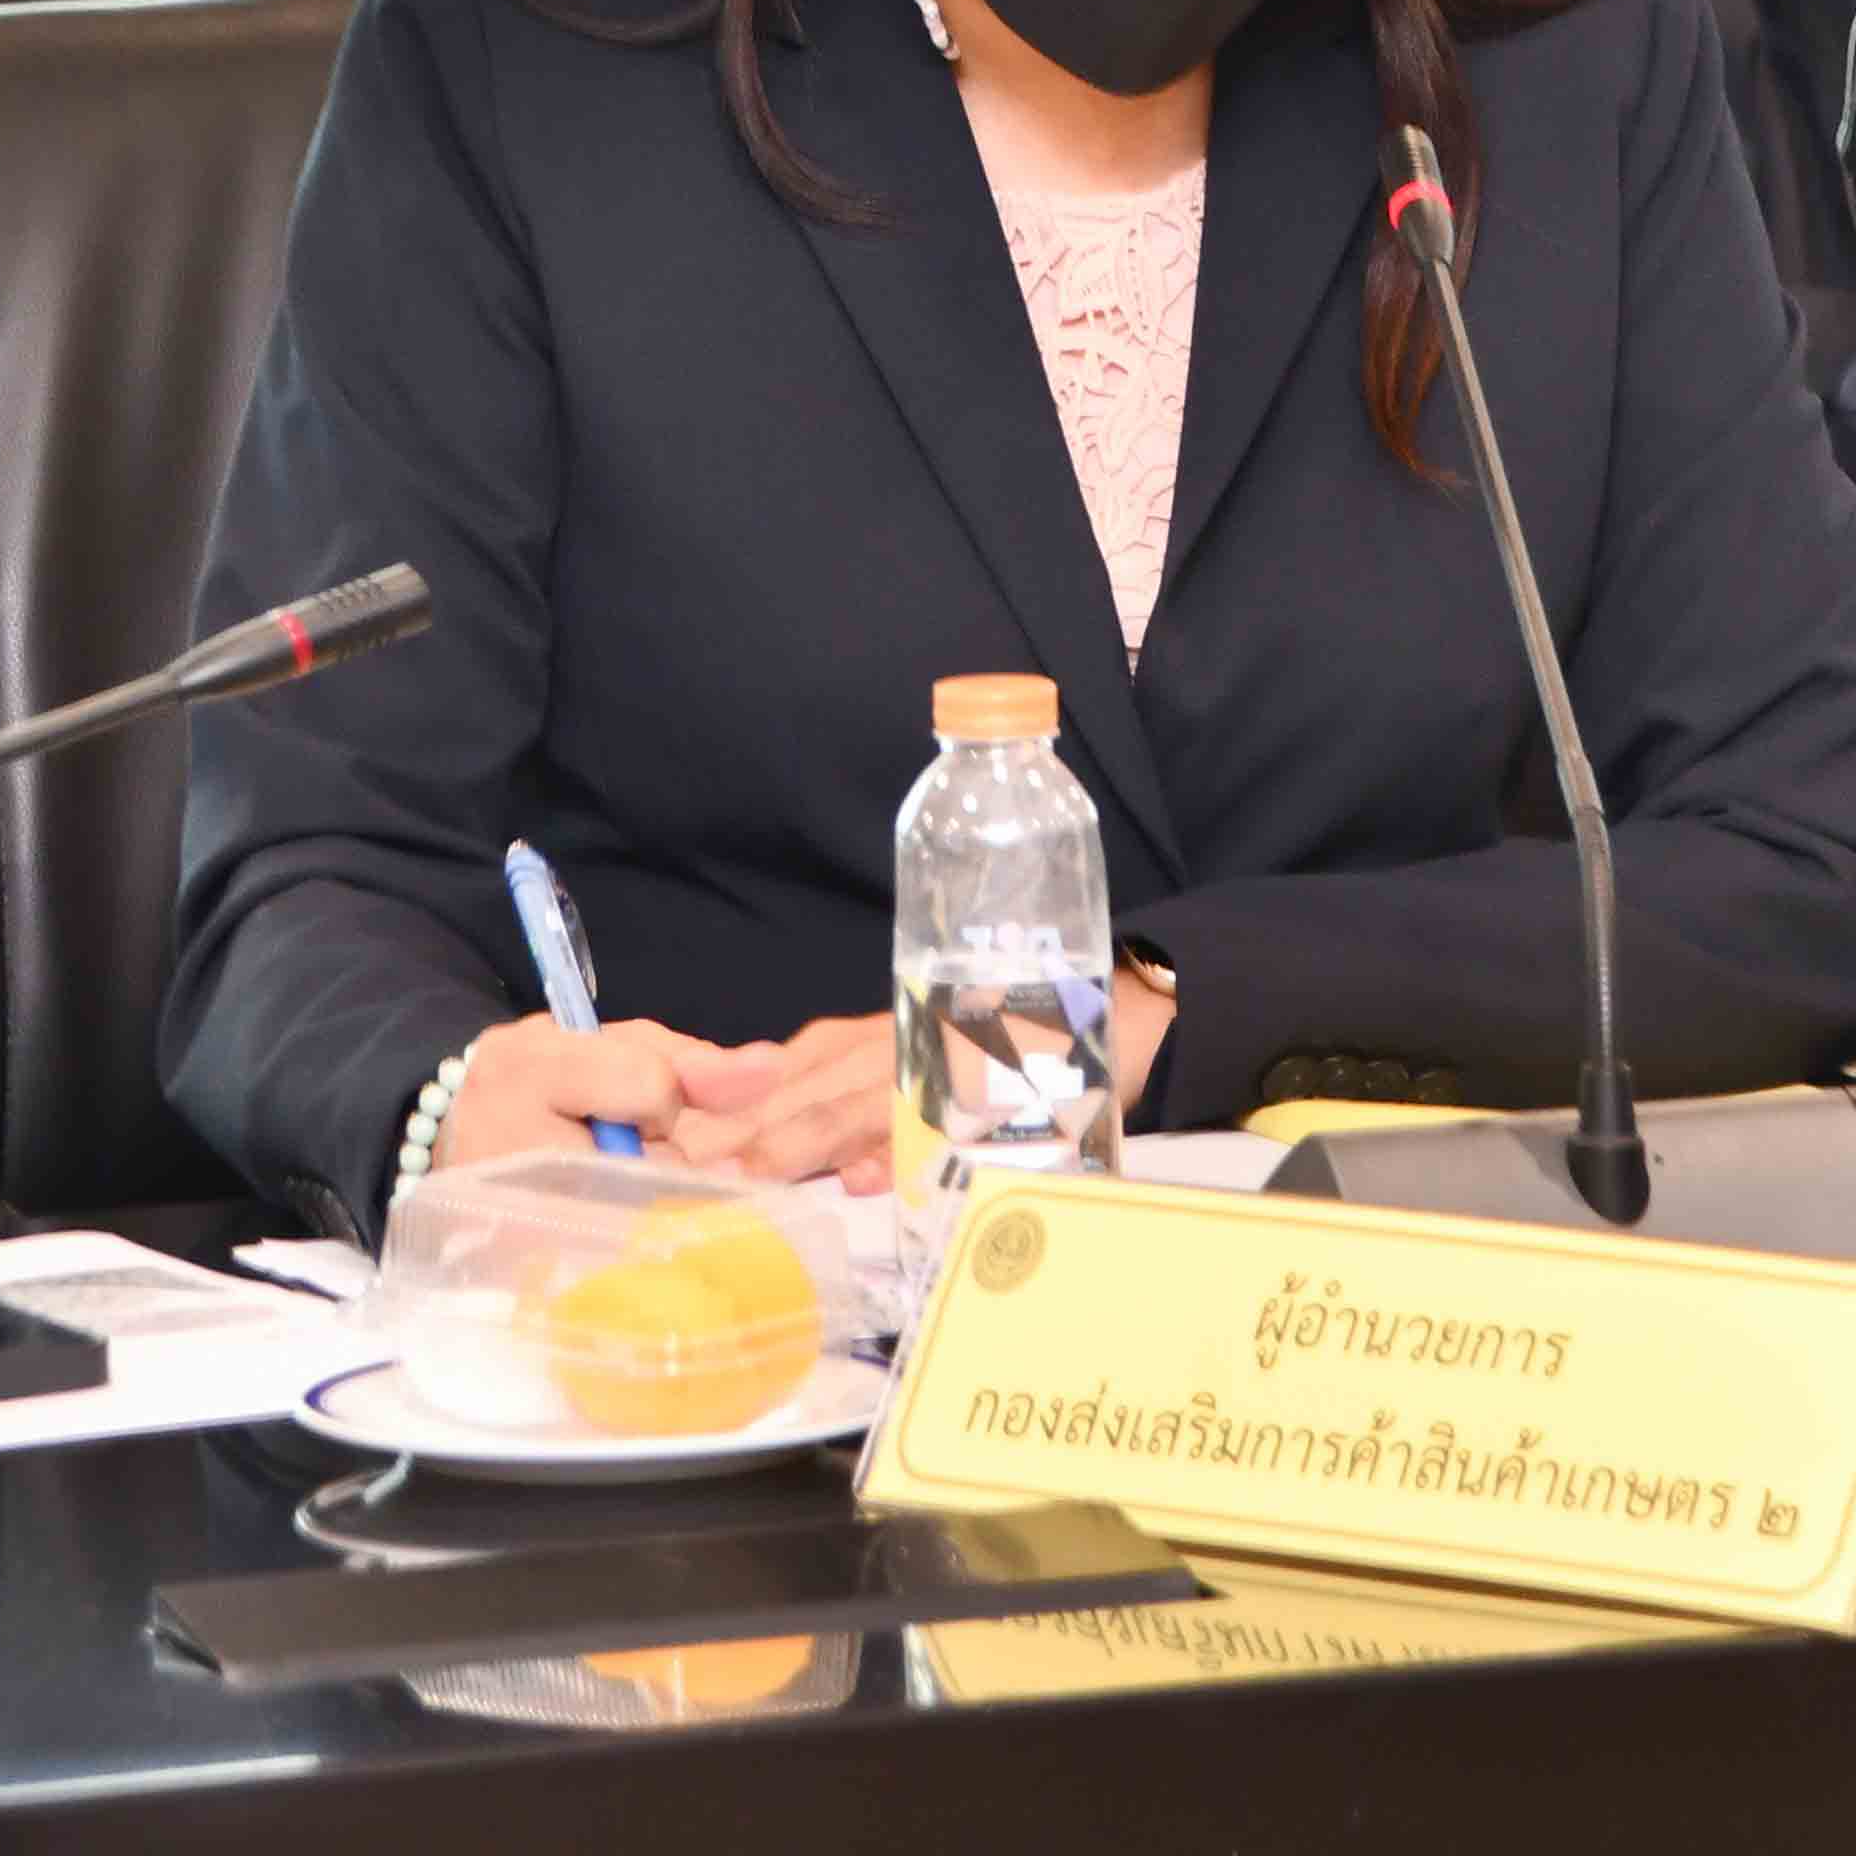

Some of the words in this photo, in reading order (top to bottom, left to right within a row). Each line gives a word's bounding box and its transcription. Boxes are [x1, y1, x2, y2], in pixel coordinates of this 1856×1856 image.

[1252, 1271, 1572, 1380] ผู้อำนวยการ
[963, 1380, 1736, 1530] กองส่งเสริมการค้าสินค้าเกษตร
